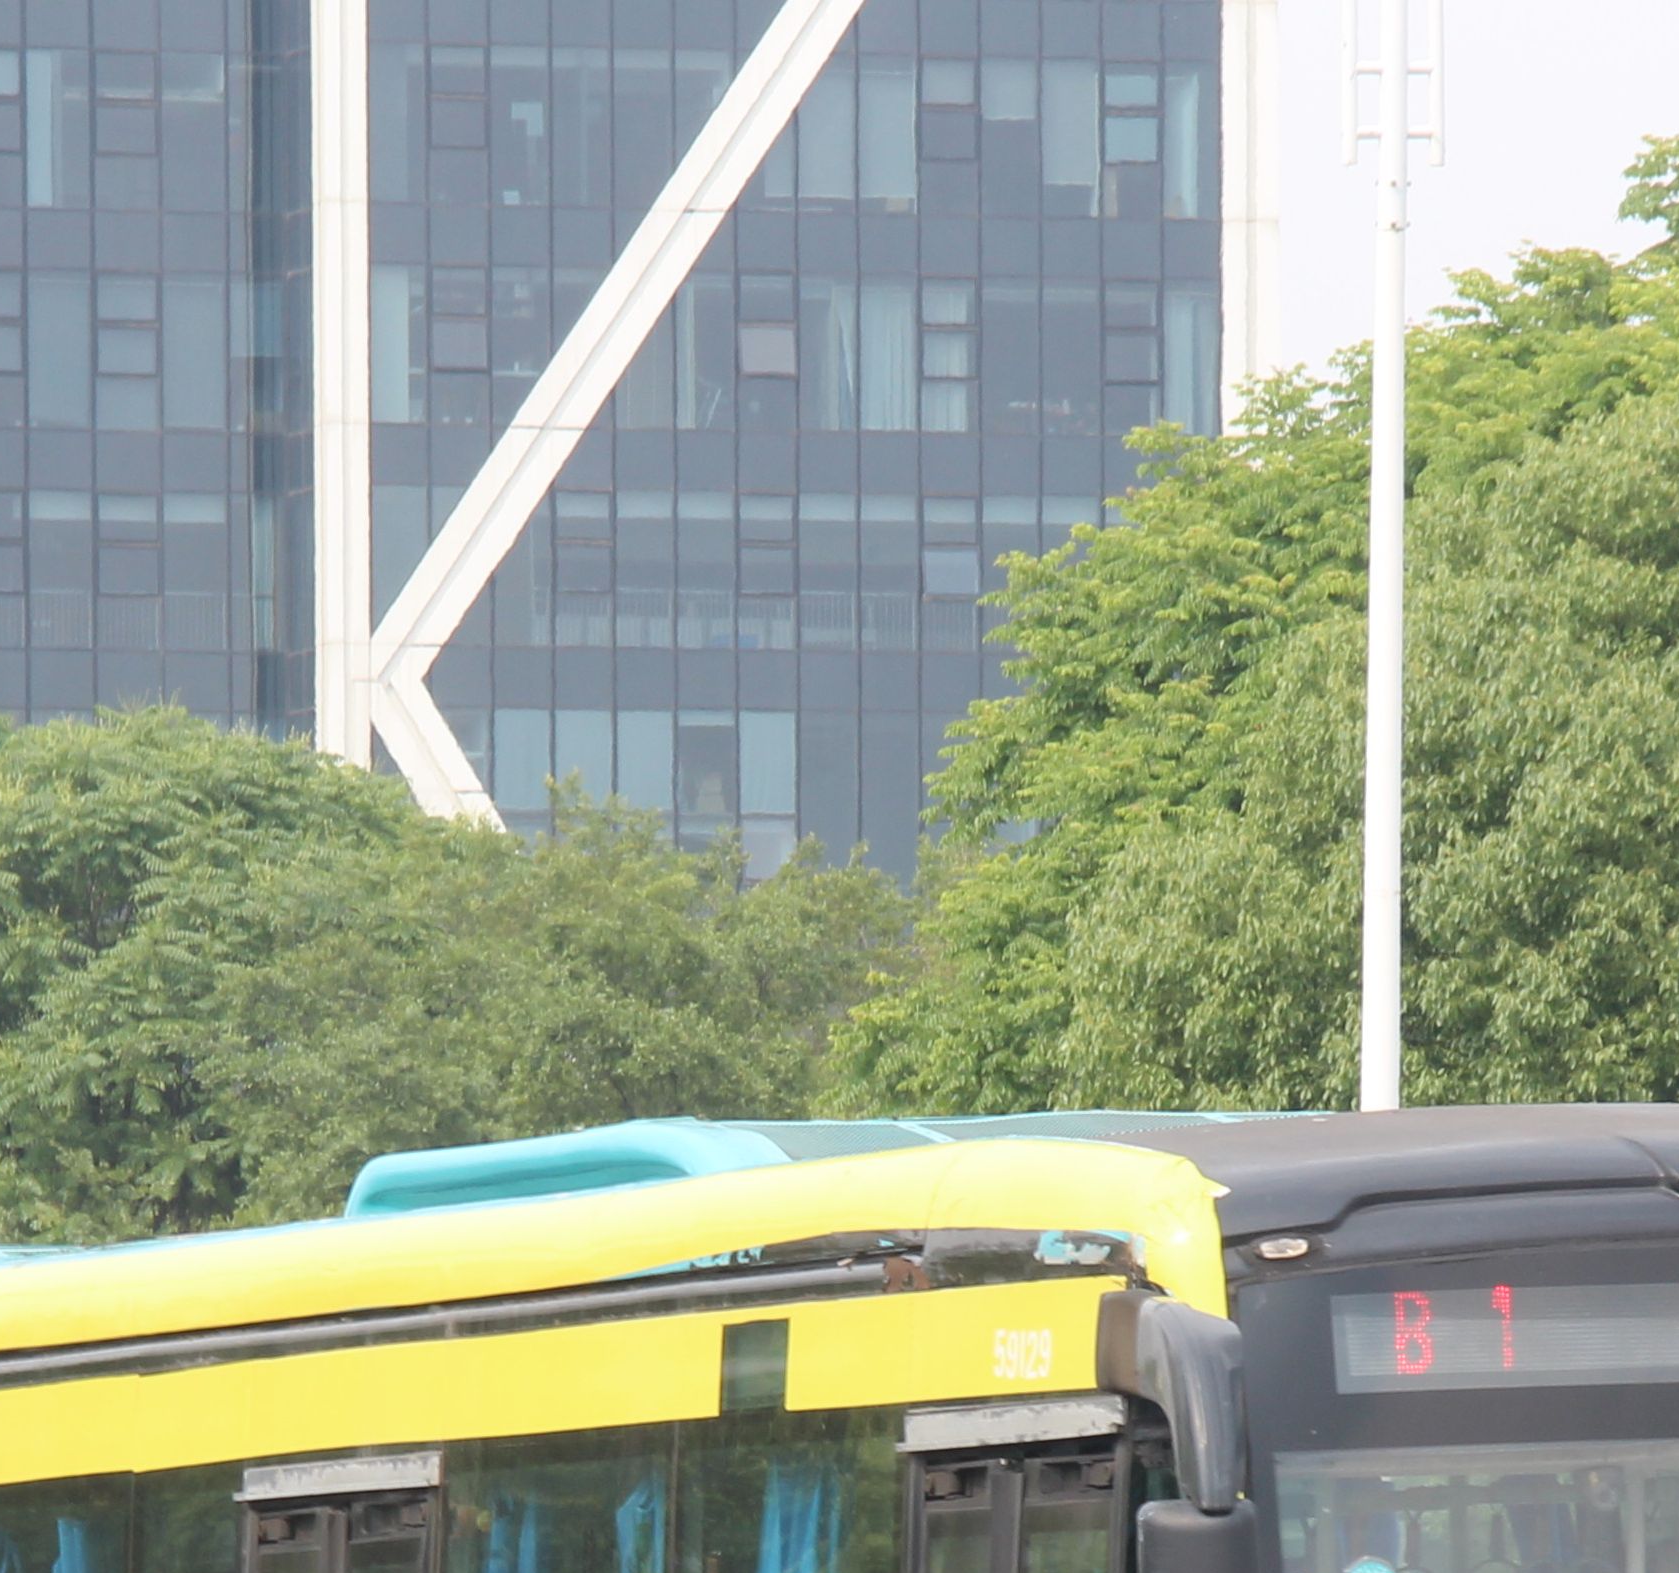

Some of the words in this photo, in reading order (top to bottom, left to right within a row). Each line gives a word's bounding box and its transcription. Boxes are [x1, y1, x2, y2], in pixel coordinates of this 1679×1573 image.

[993, 1328, 1050, 1379] 59129
[1394, 1290, 1434, 1375] B
[1491, 1284, 1514, 1370] 1
